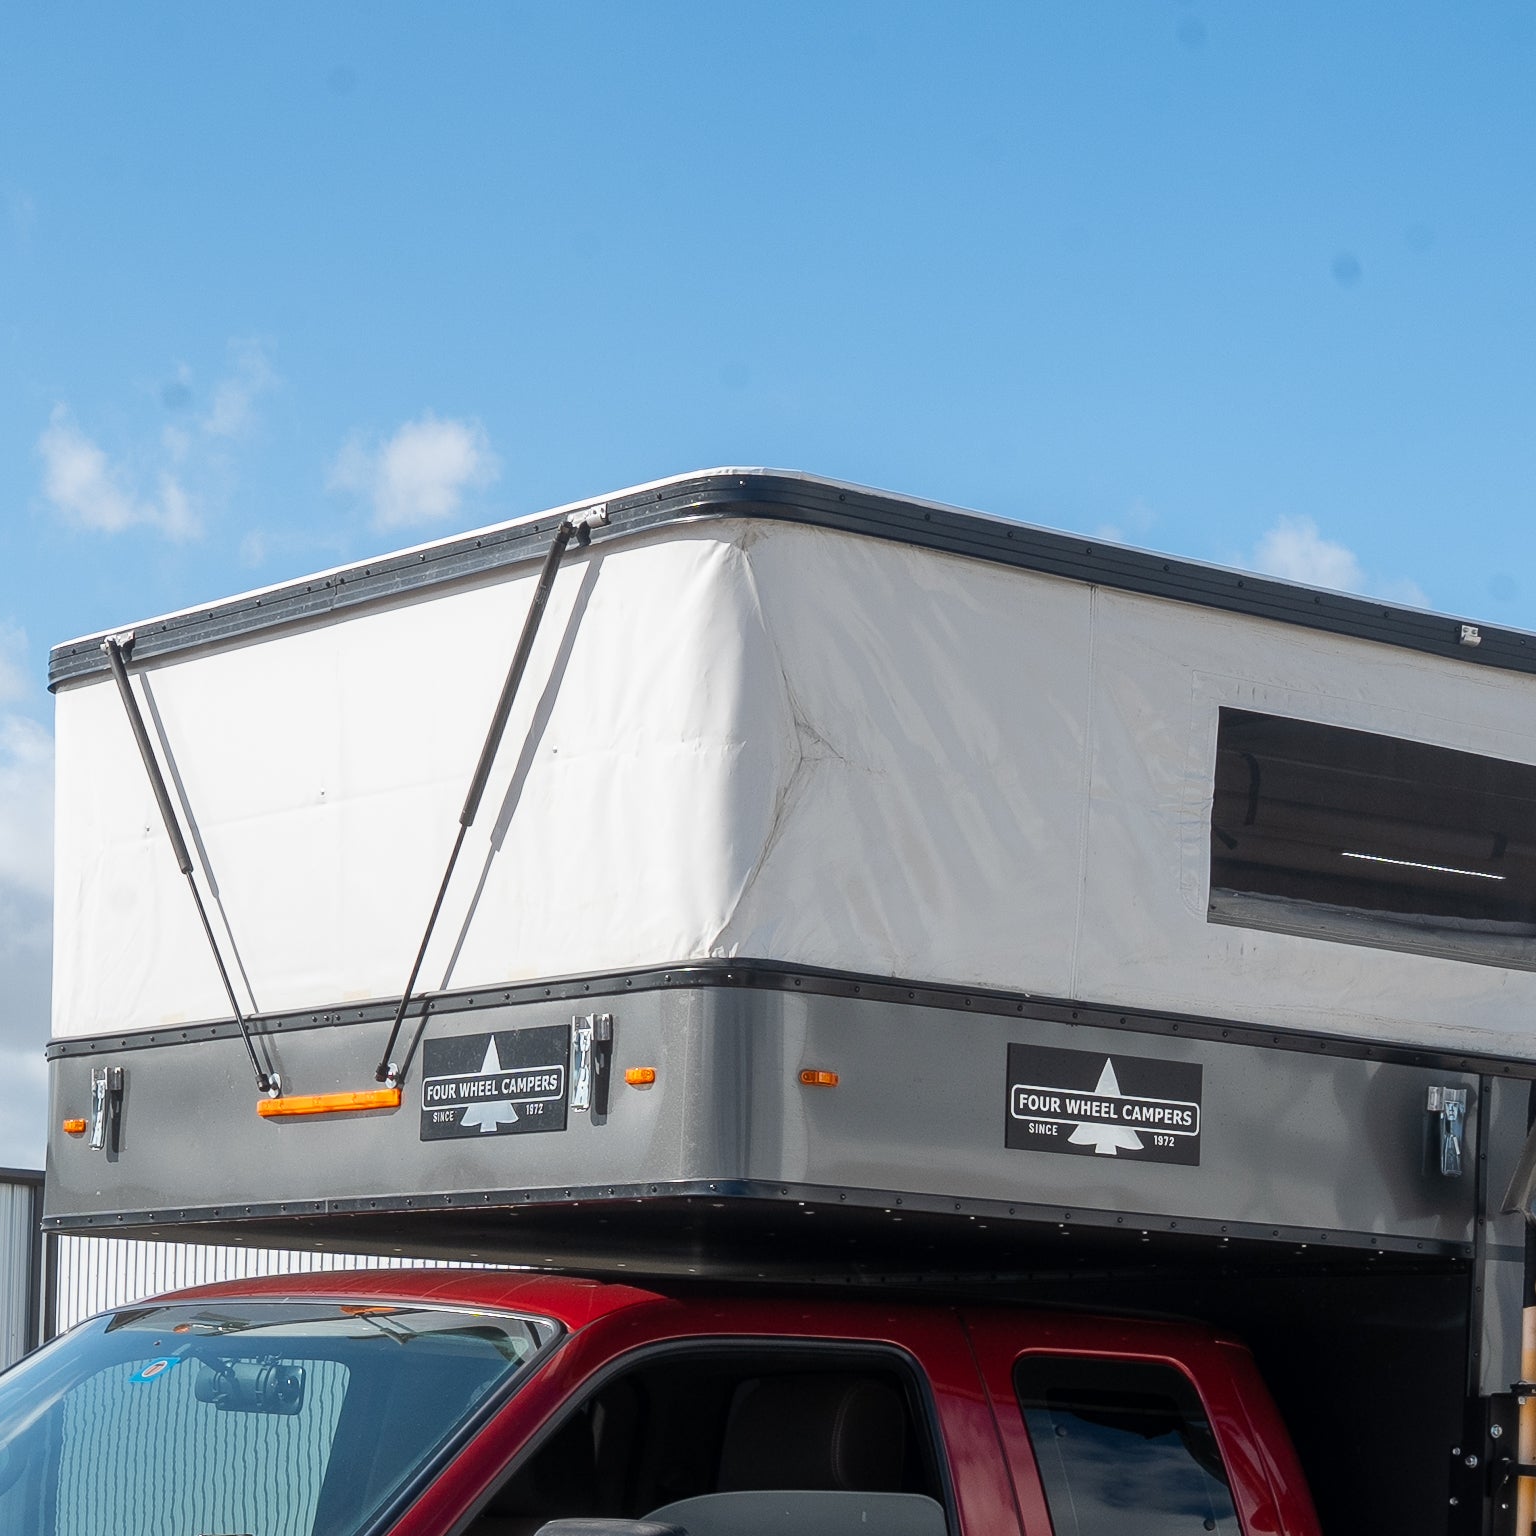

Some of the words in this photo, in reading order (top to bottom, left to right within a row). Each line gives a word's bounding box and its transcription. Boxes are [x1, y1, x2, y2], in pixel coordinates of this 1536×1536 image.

[427, 1083, 457, 1101] FOUR
[459, 1080, 499, 1098] WHEEL
[501, 1074, 558, 1094] CAMPERS
[432, 1110, 454, 1123] SINCE
[525, 1103, 544, 1115] 1972
[1019, 1093, 1061, 1113] FOUR
[1065, 1098, 1119, 1119] WHEEL
[1122, 1104, 1192, 1126] CAMPERS
[1028, 1122, 1059, 1136] SINCE
[1153, 1135, 1175, 1147] 1972
